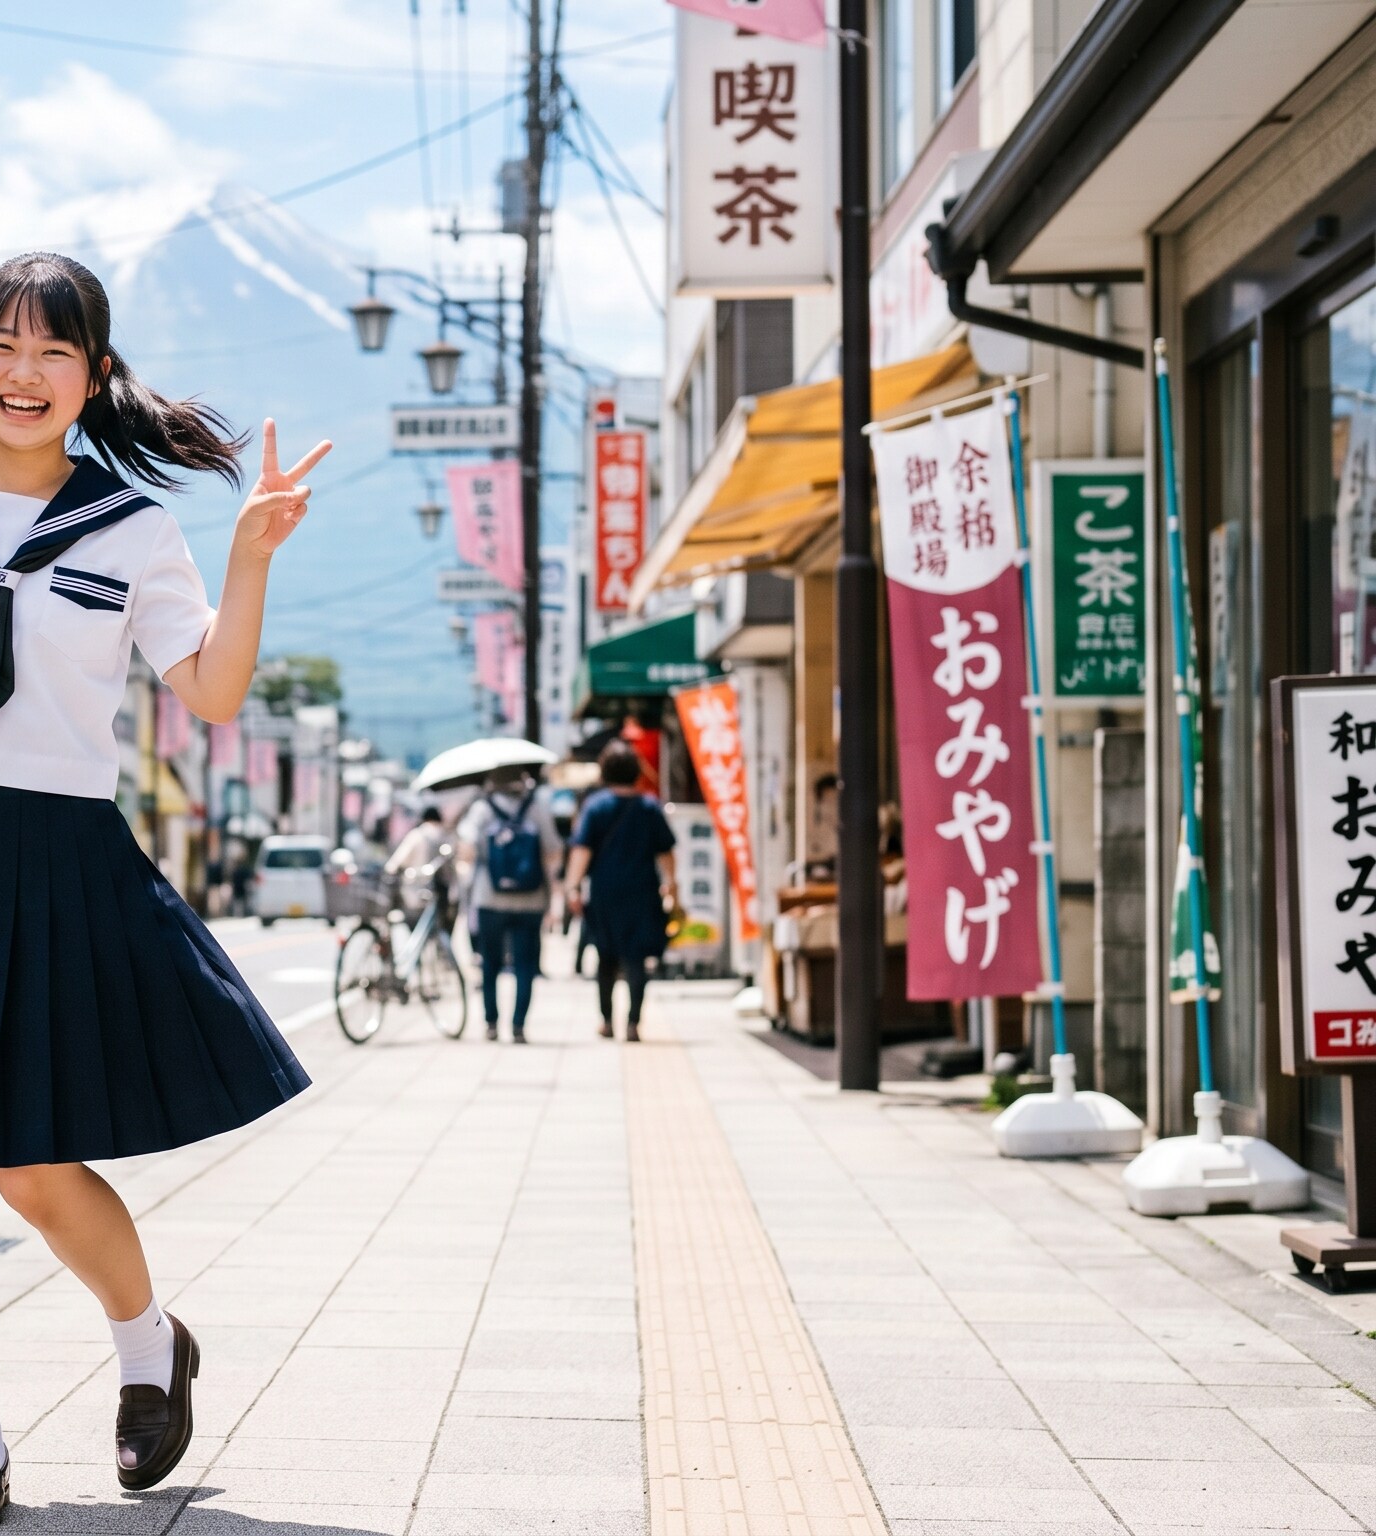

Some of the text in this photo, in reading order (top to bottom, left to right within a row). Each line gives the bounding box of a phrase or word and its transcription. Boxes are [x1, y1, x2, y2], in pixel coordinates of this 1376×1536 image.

[713, 28, 798, 247] 喫茶
[905, 455, 949, 578] 御殿場
[930, 606, 1019, 972] おみやげ
